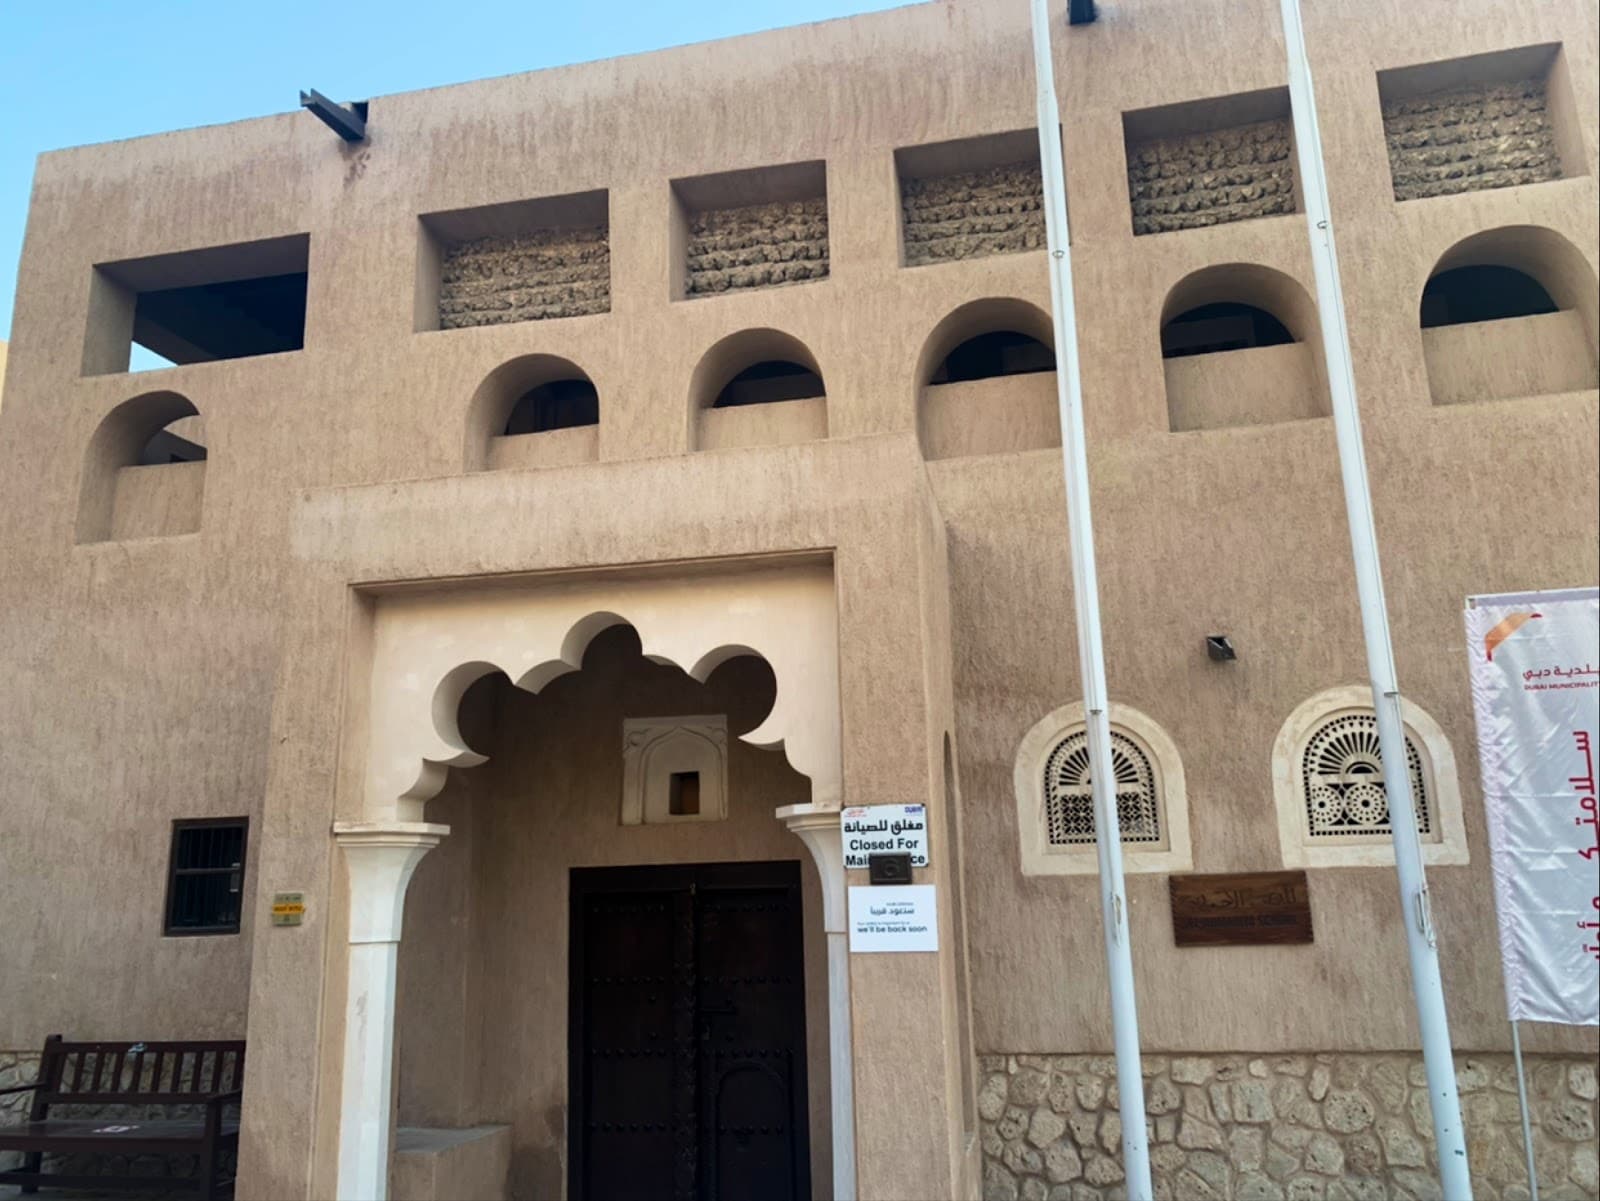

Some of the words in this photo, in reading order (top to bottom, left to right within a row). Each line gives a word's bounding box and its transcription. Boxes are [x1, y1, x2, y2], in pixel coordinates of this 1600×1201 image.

[1522, 668, 1551, 681] دبي
[1553, 664, 1599, 679] لدية
[1524, 683, 1547, 691] DUBAI
[844, 819, 888, 835] للصيانة
[890, 818, 923, 836] مغلق
[849, 838, 894, 851] Closed
[897, 838, 919, 849] For
